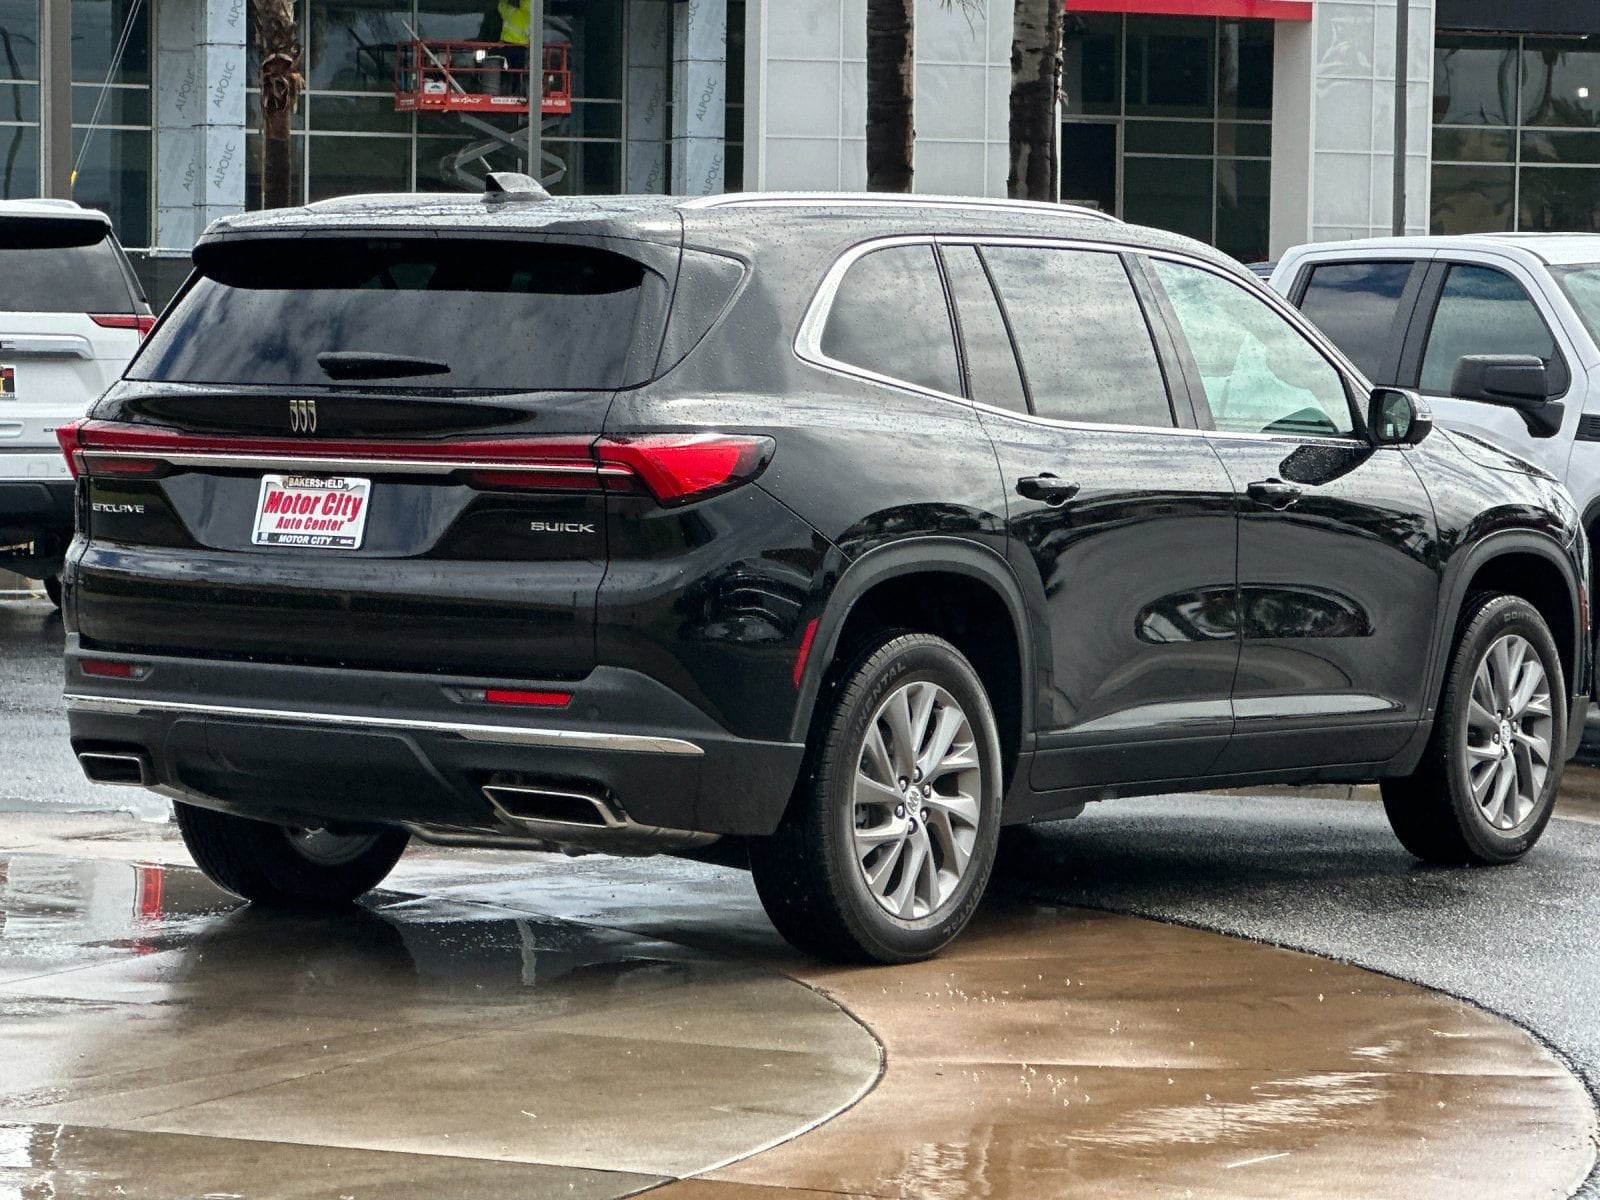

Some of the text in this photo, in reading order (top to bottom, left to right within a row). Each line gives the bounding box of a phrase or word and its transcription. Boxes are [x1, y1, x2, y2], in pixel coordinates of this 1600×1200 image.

[213, 62, 236, 108] ALPOLIC
[695, 77, 717, 121] ALPOLIC
[213, 143, 236, 189] ALPOLIC
[702, 154, 723, 195] ALPOLIC
[288, 477, 344, 489] BAKERSFIELD
[264, 490, 363, 523] Motor City
[276, 516, 345, 532] Auto Center
[278, 534, 310, 544] MOTOR
[311, 535, 332, 545] CITY
[531, 521, 595, 533] BUICK
